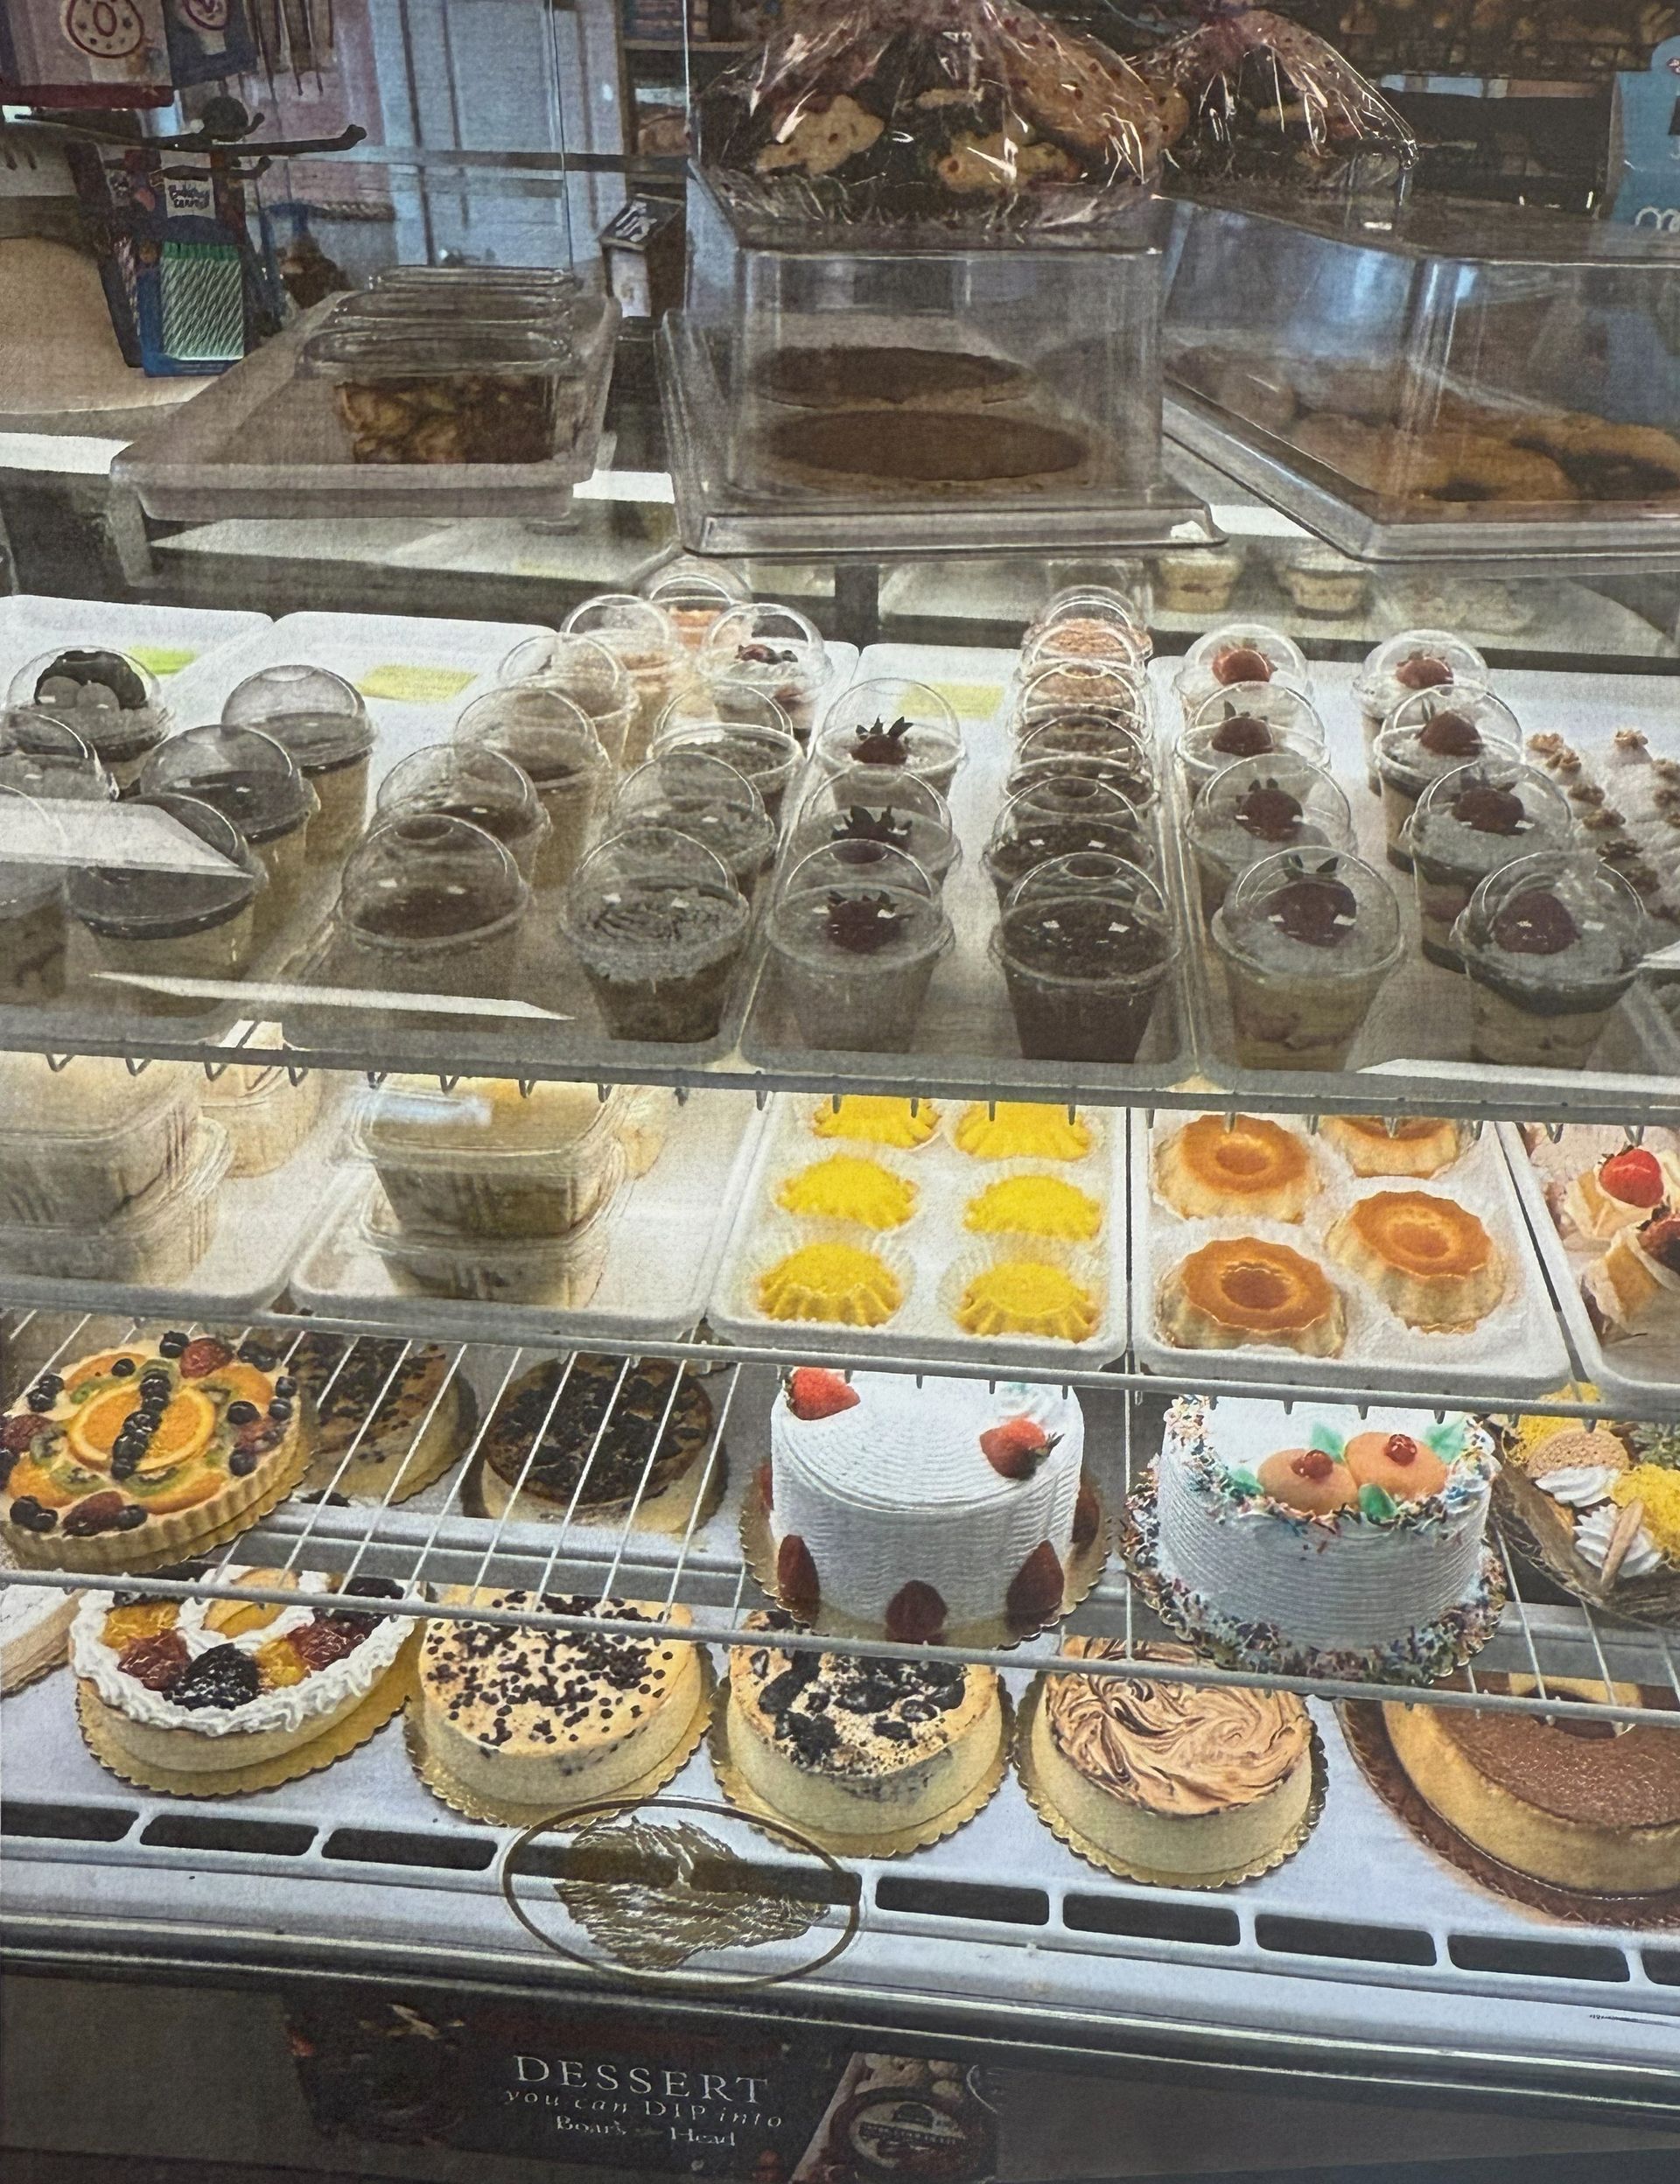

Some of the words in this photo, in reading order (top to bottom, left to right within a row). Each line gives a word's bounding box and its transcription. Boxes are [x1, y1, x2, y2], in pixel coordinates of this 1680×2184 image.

[513, 2054, 768, 2104] DESSERT
[505, 2090, 559, 2106] you
[574, 2099, 627, 2114] can
[644, 2100, 706, 2120] DIP
[718, 2107, 782, 2128] into
